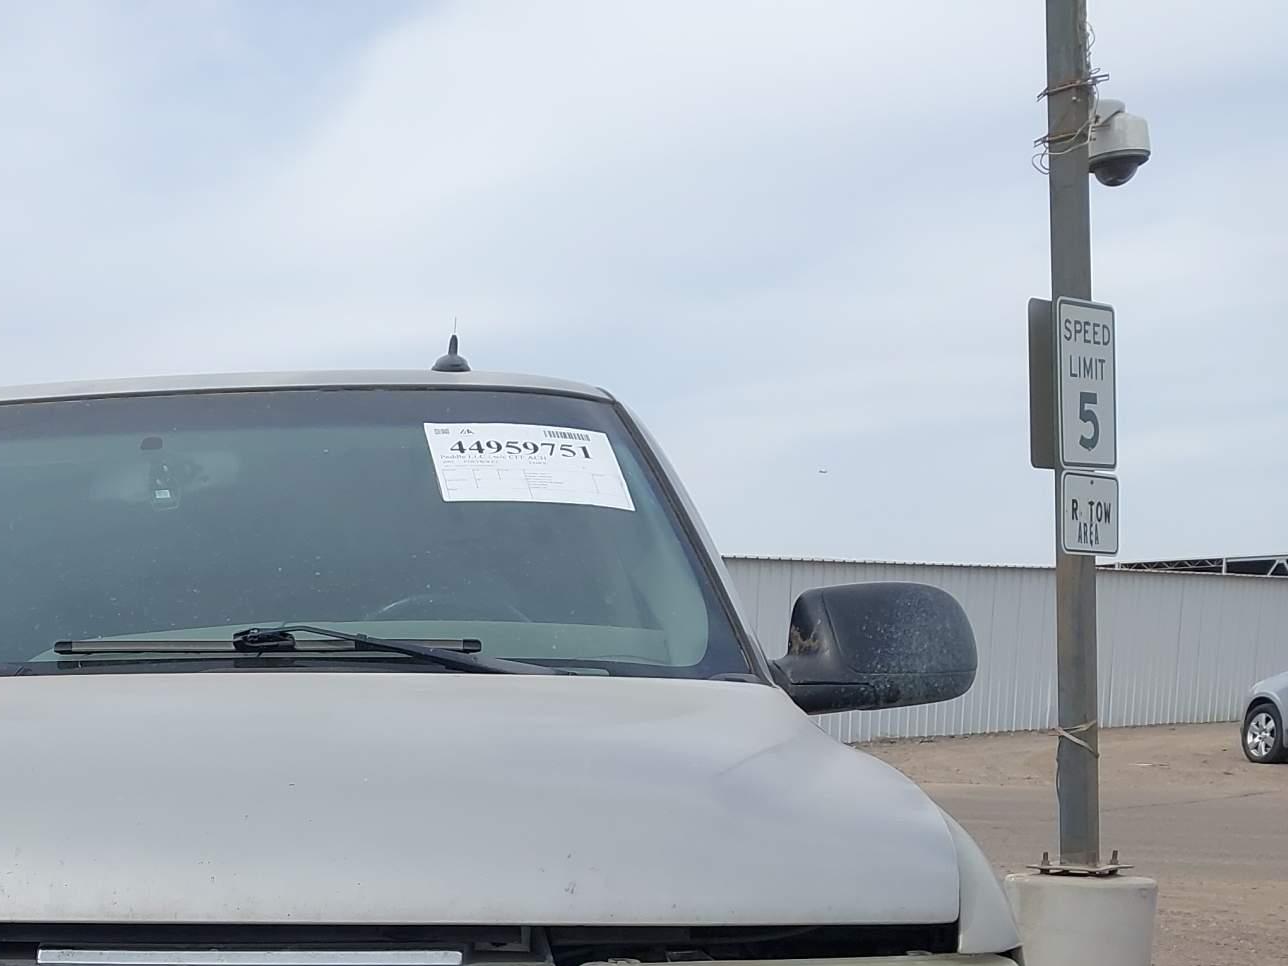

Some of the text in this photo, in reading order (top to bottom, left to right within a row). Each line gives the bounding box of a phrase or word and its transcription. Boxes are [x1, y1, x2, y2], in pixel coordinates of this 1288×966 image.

[1064, 318, 1110, 346] SPEED
[1069, 354, 1106, 381] LIMIT
[1079, 391, 1100, 452] 5
[449, 439, 593, 460] 44959751
[1088, 500, 1112, 524] TOW
[1077, 521, 1100, 545] AREA
